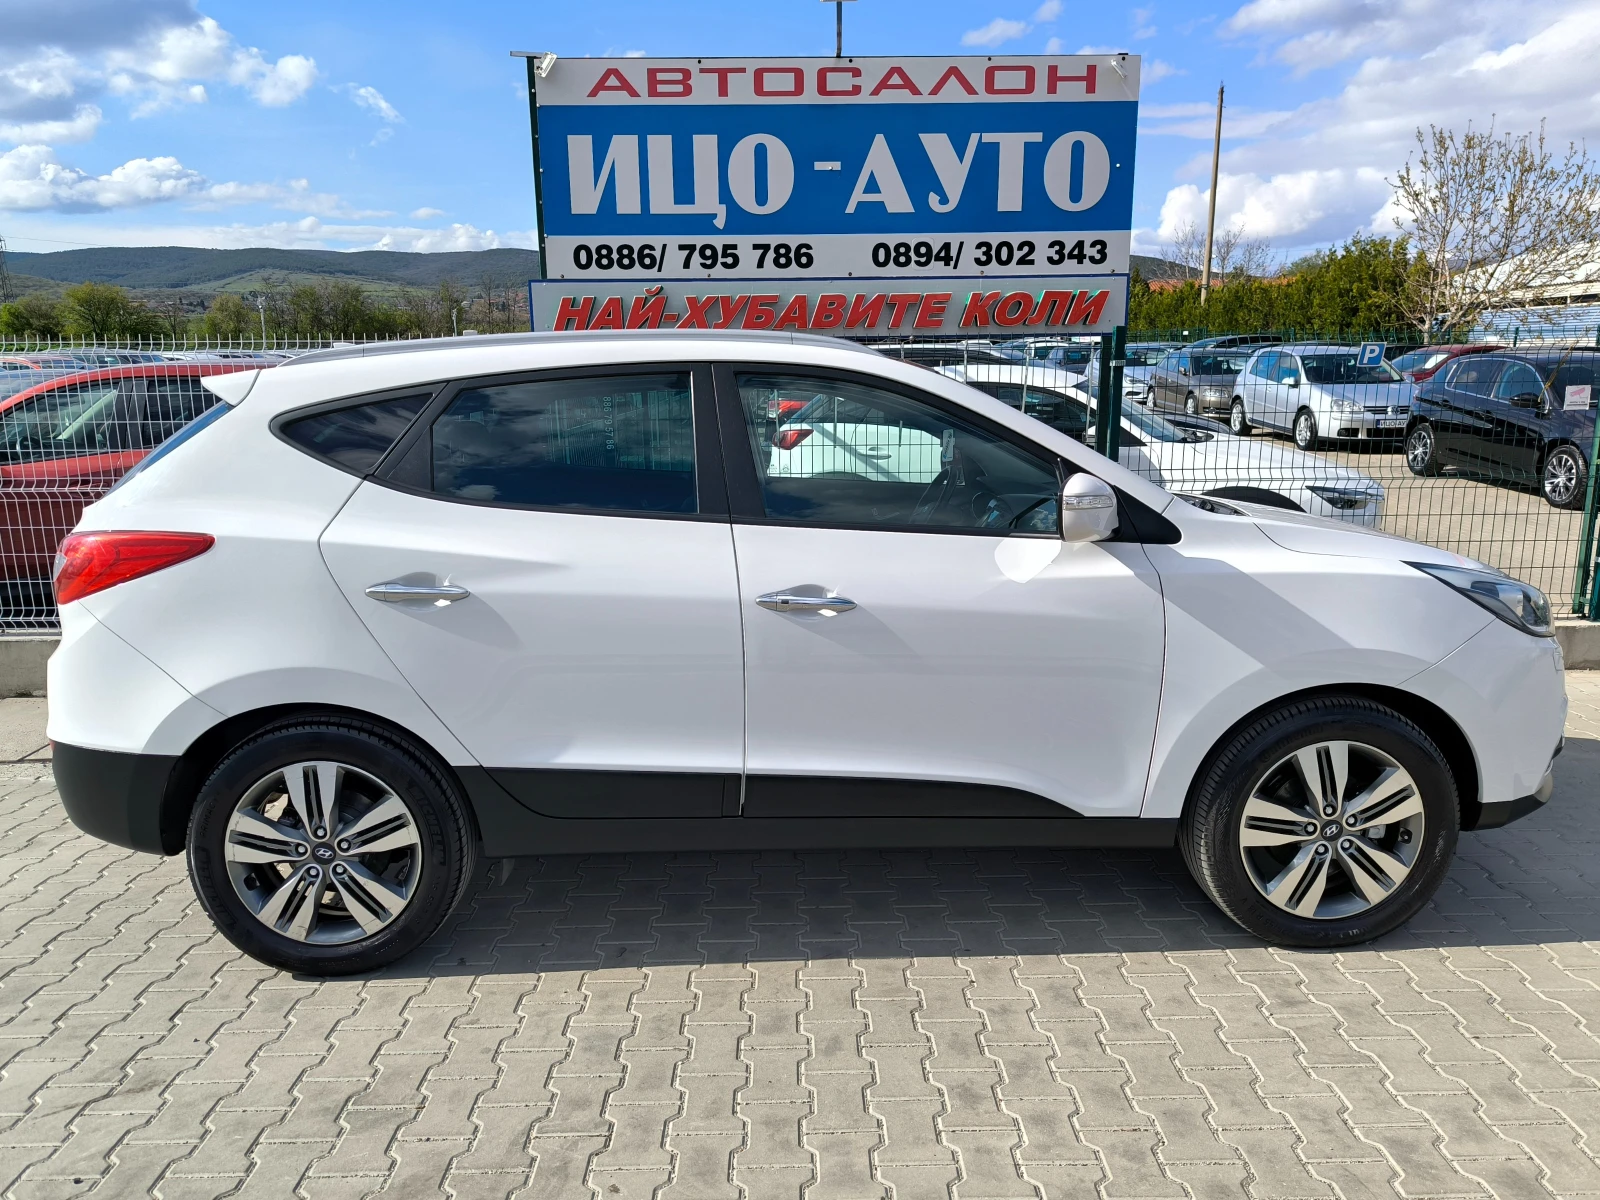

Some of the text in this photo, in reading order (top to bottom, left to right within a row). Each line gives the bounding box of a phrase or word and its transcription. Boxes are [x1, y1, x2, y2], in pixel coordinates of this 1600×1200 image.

[587, 65, 1097, 97] АВТОСАЛОН
[573, 243, 815, 273] 0886/ 795 786
[871, 239, 1109, 269] 0894/ 302 343
[554, 285, 1110, 331] НАЙ-ХУБАВИТЕ КОЛИ
[1363, 345, 1380, 364] P
